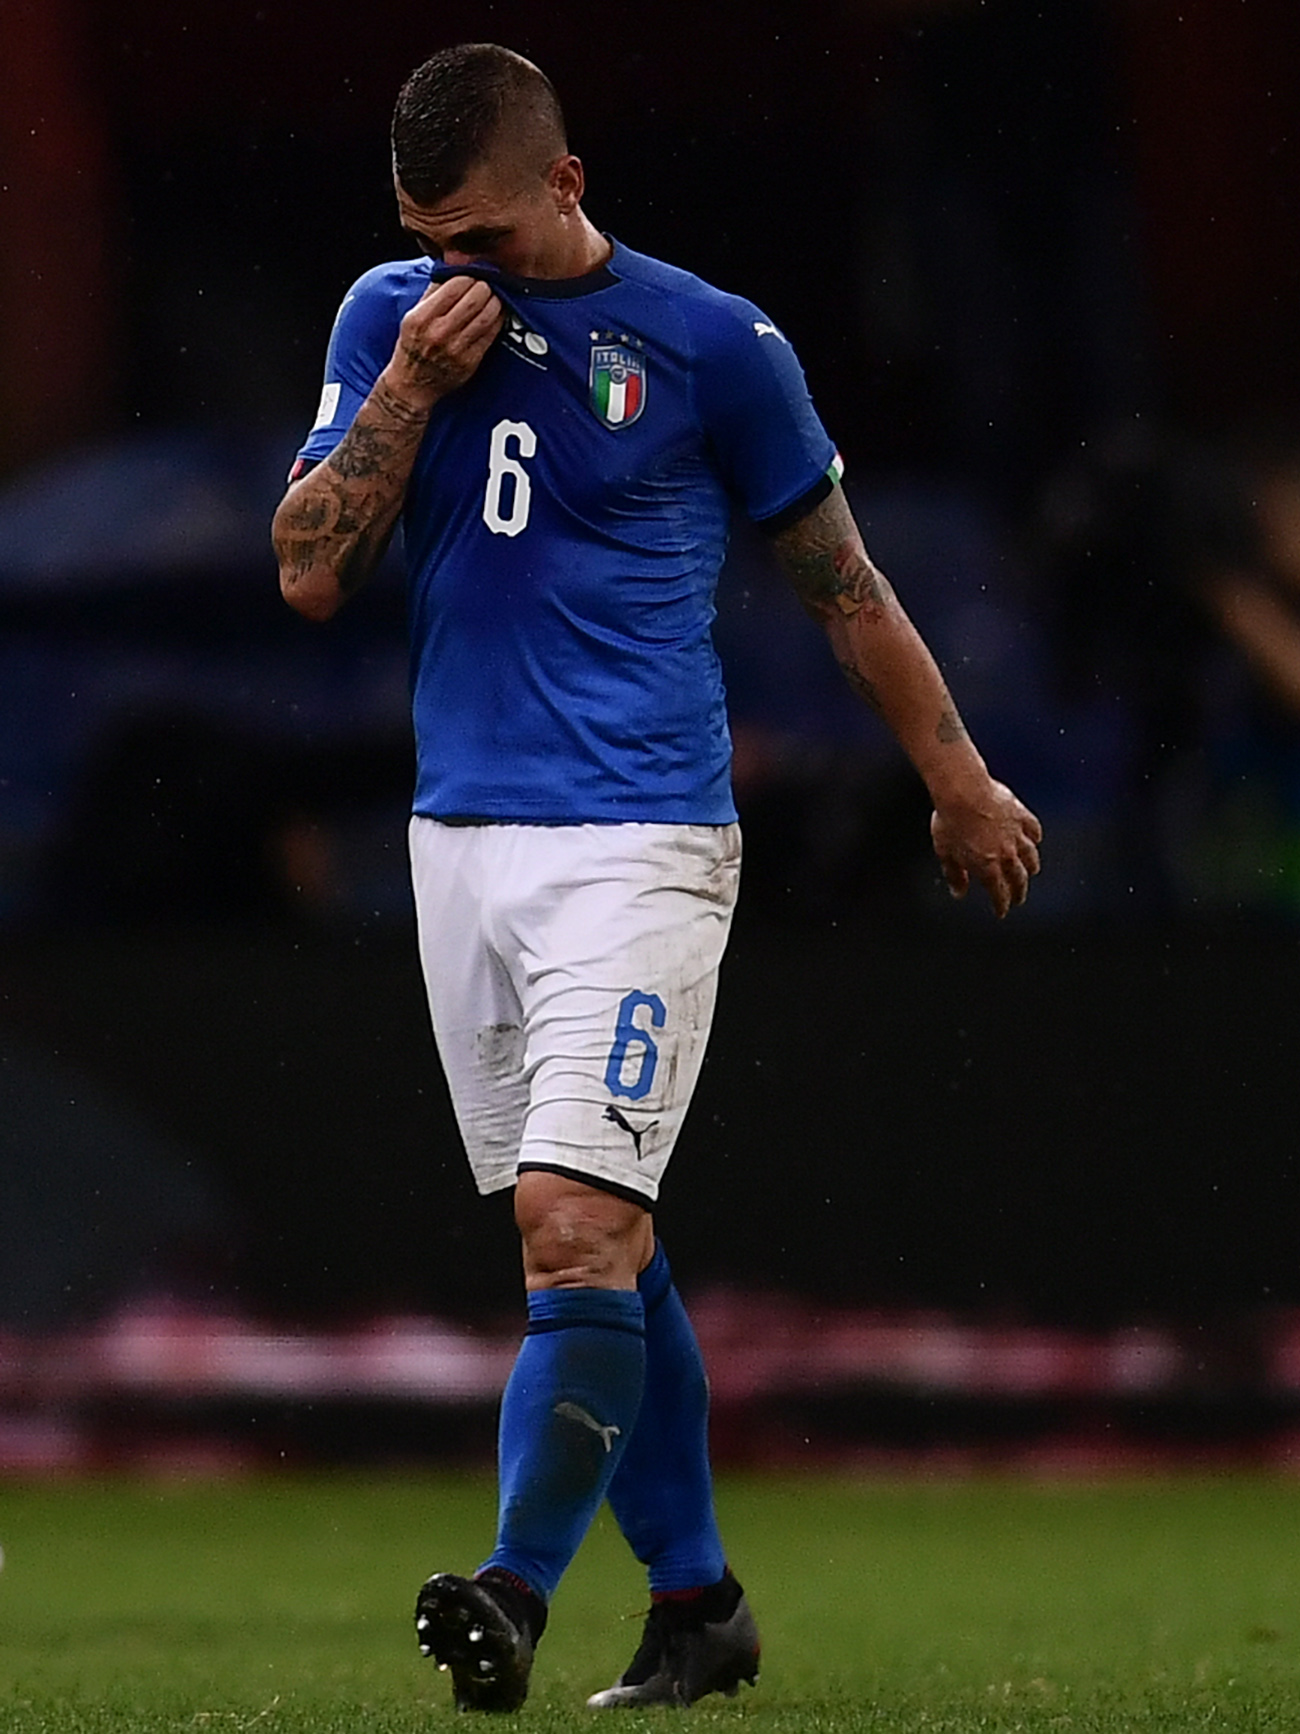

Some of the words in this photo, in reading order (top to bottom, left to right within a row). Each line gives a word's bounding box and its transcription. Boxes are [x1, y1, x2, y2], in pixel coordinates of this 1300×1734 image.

[596, 351, 641, 369] ITALIA
[483, 419, 537, 537] 6
[604, 989, 666, 1100] 6
